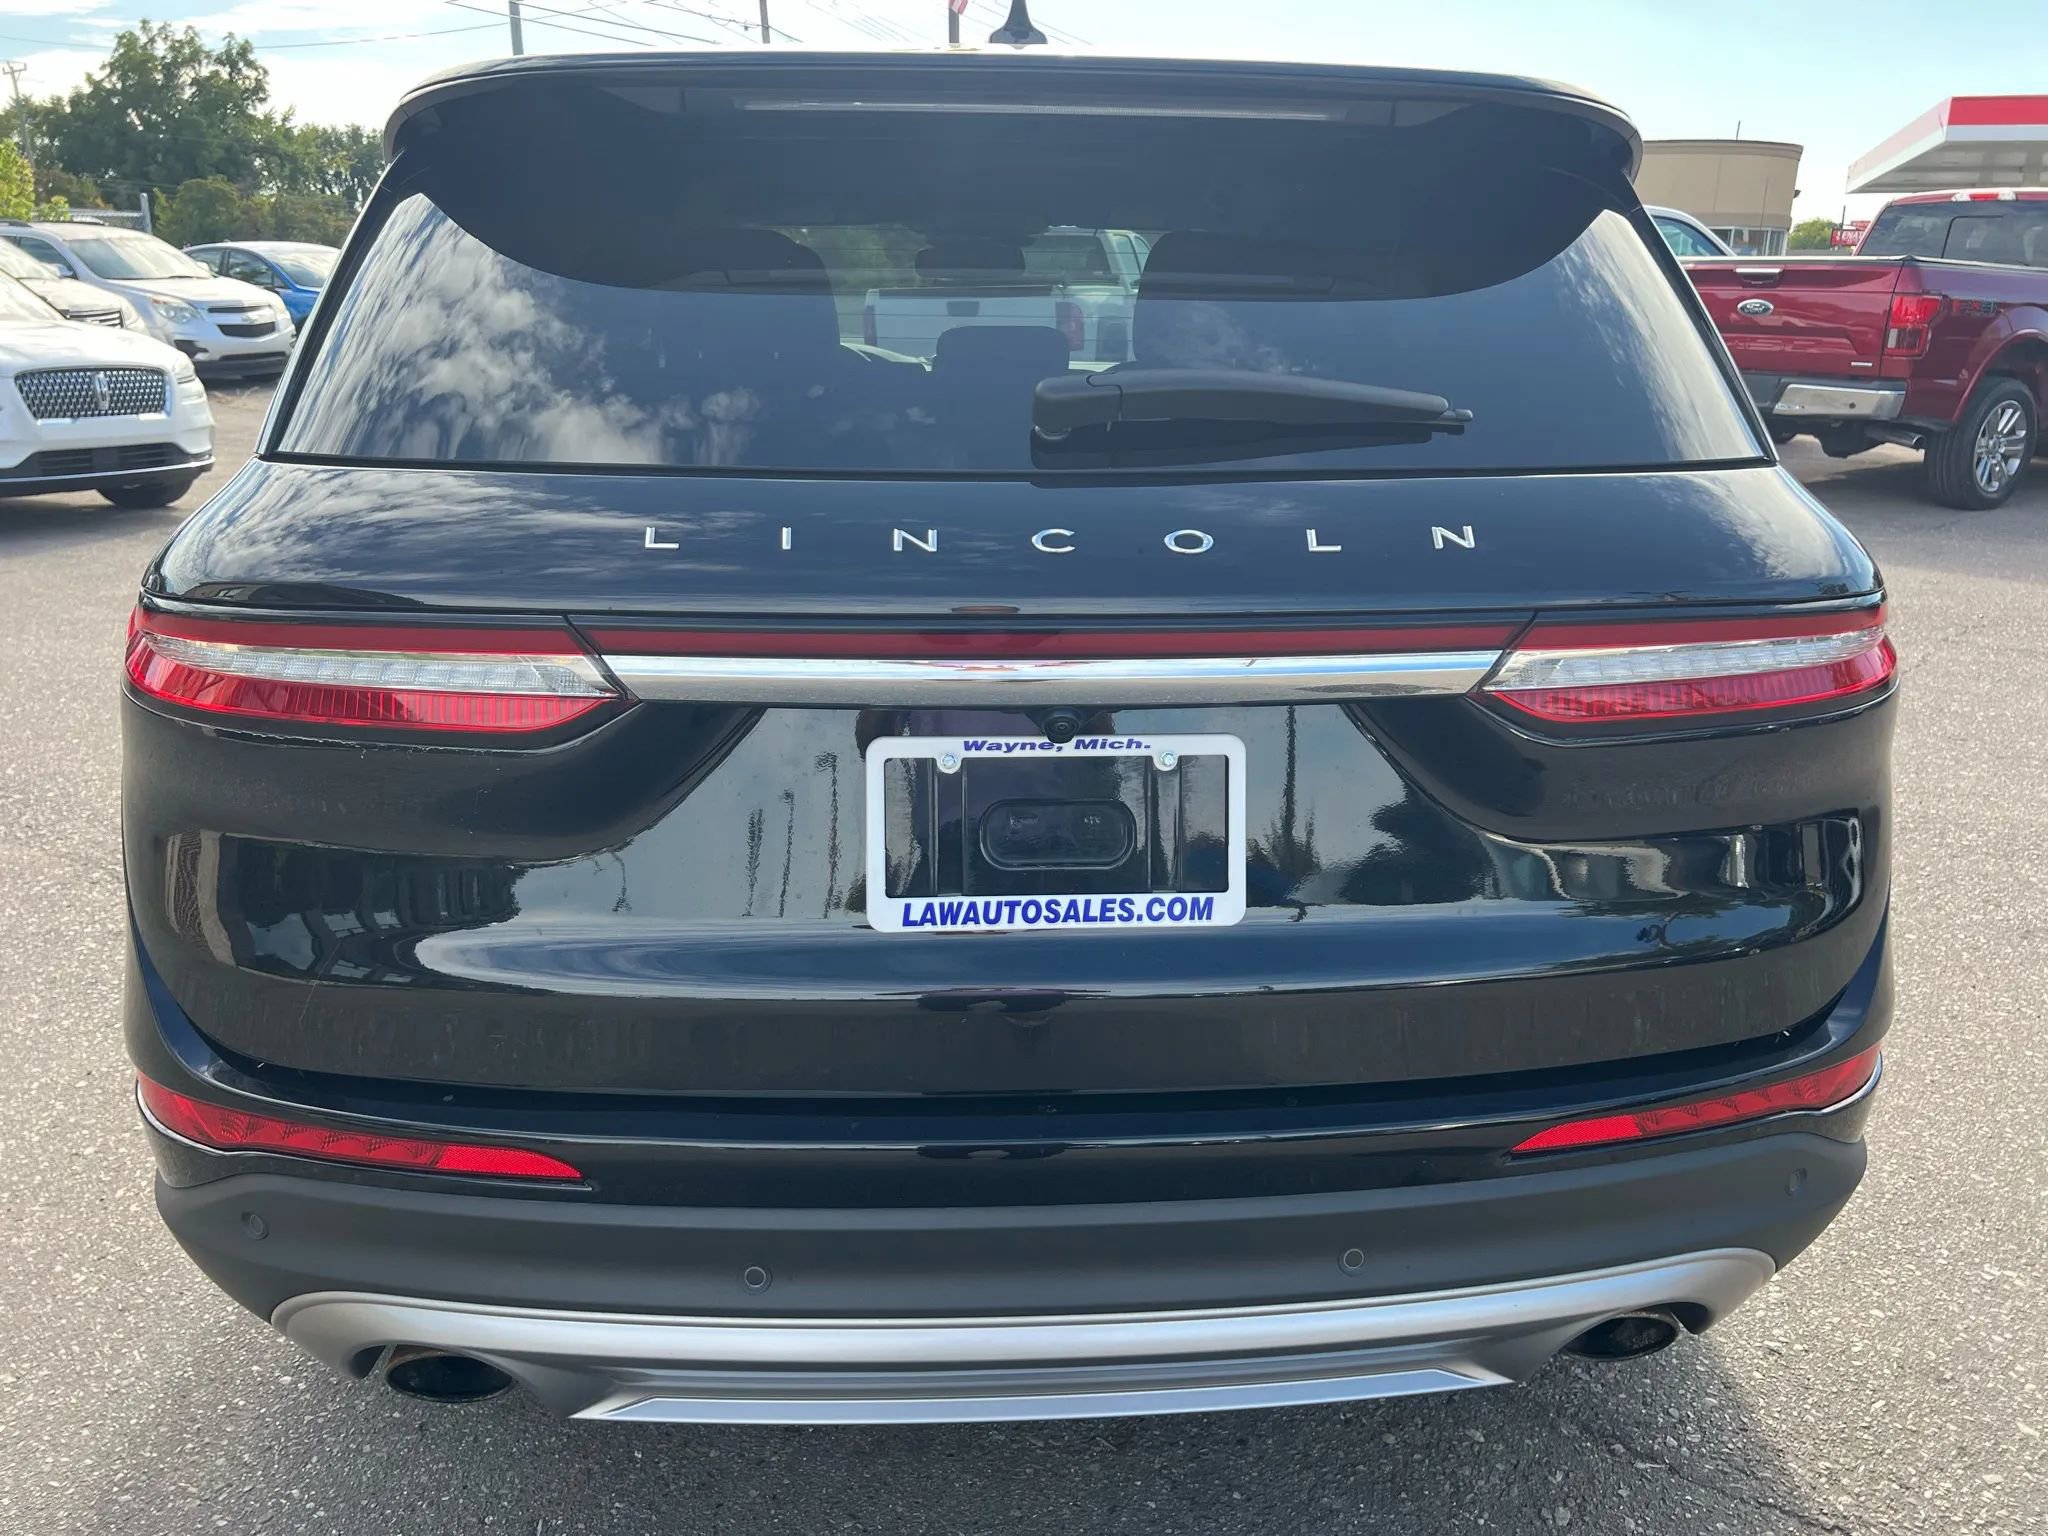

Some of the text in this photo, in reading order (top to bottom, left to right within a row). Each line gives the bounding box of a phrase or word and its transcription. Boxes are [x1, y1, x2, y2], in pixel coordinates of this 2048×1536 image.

[643, 524, 1476, 554] LINCOLN
[963, 738, 1151, 753] Wayne, Mich.
[902, 896, 1214, 927] LAWAUTOSALES.COM
